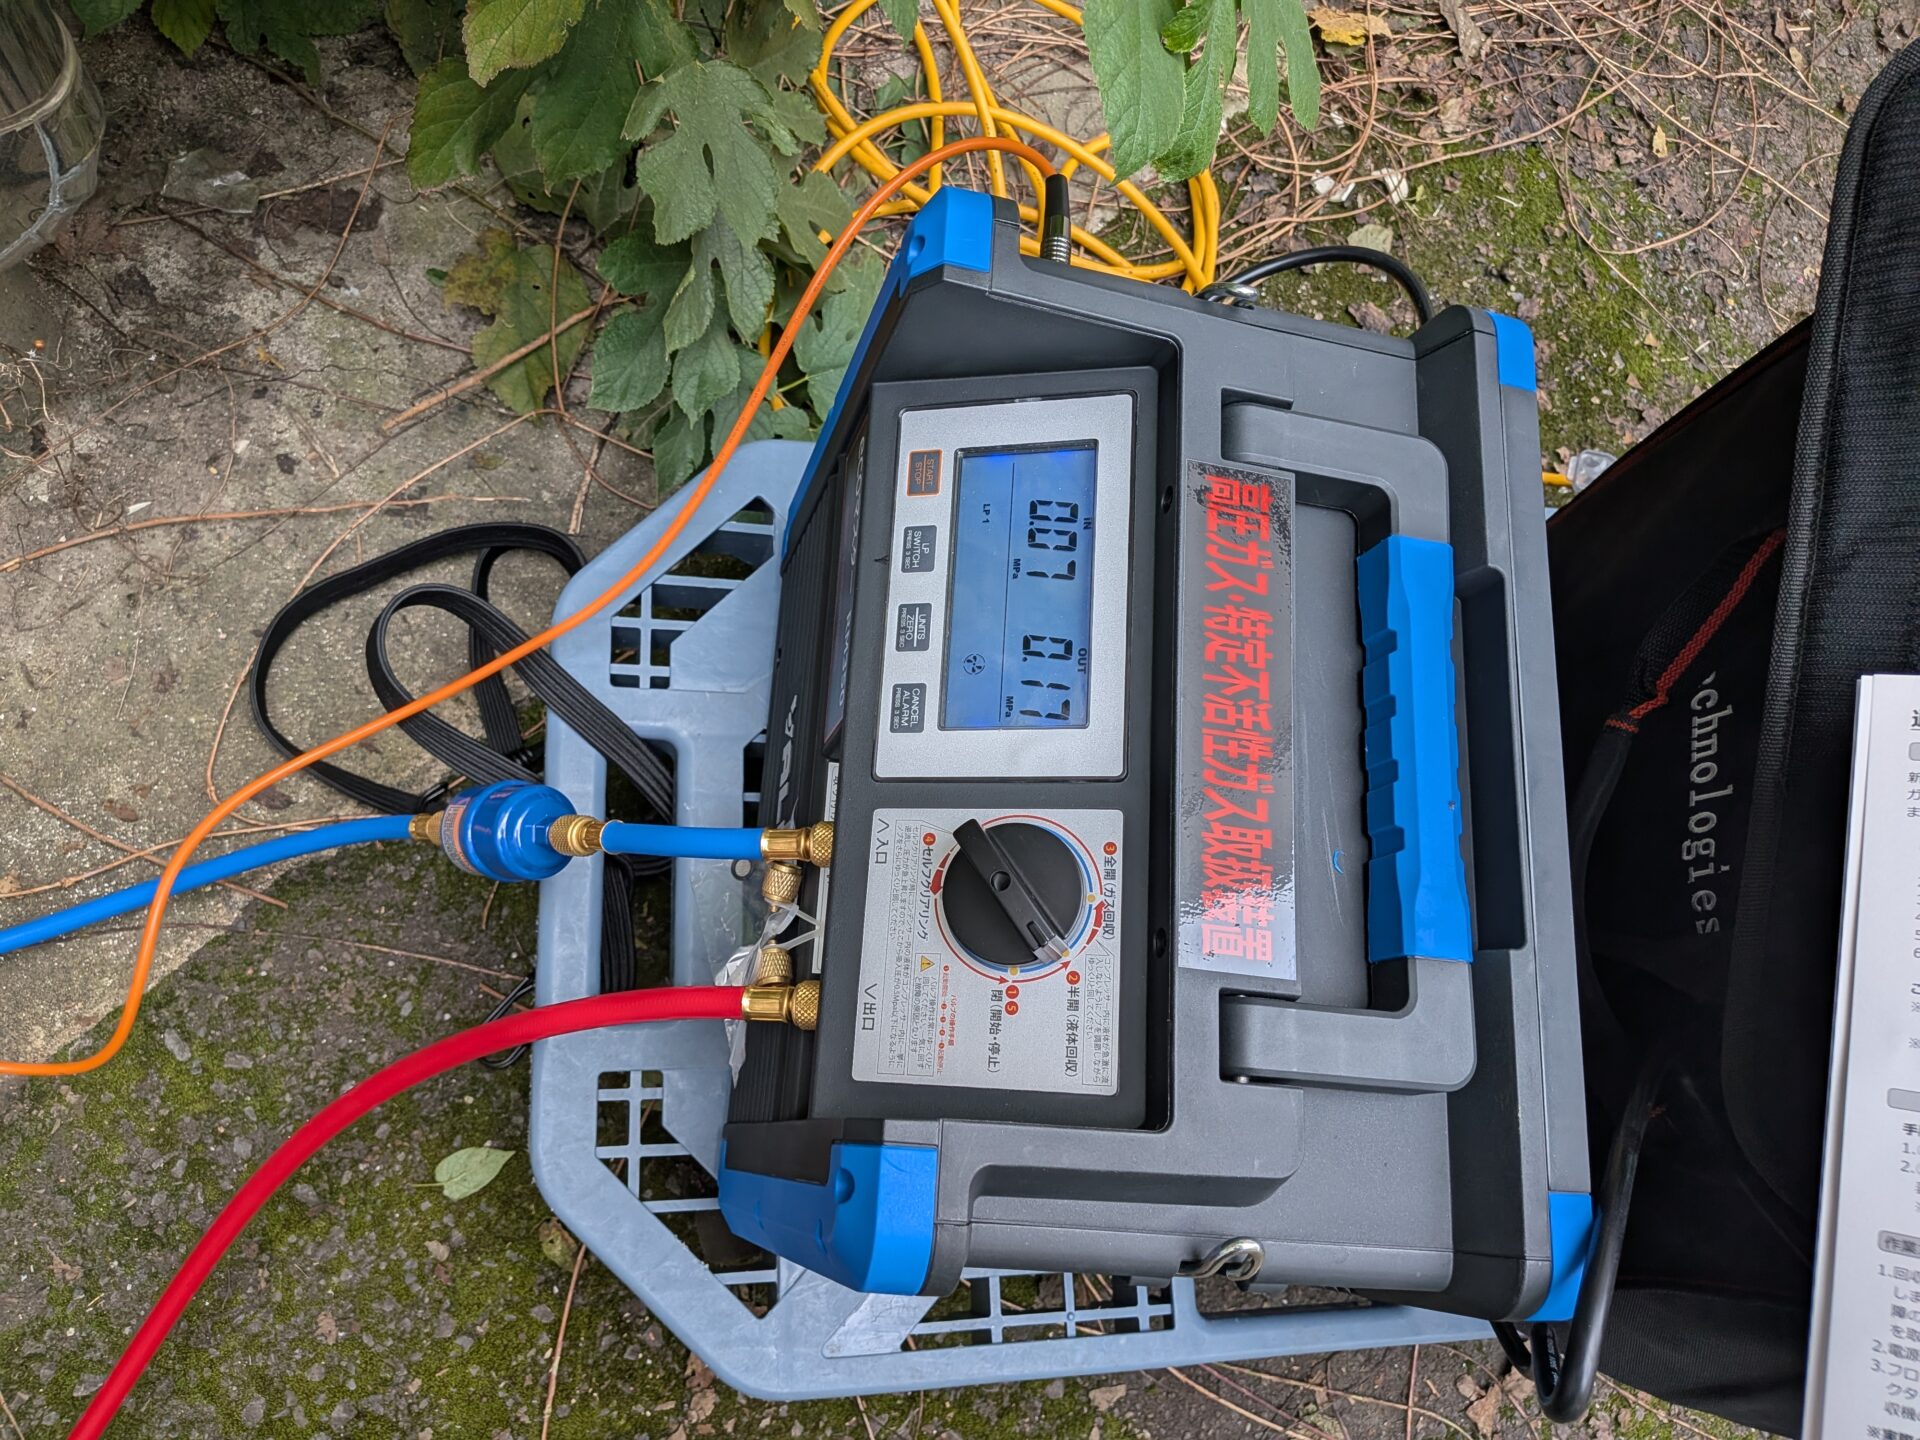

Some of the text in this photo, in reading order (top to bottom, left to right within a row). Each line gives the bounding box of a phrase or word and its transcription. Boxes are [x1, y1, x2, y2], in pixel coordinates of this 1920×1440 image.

[914, 461, 923, 484] STOP
[926, 458, 934, 485] START
[982, 503, 991, 516] LP
[1083, 517, 1092, 530] IN
[912, 531, 921, 568] SWITCH
[921, 542, 930, 554] LP
[1026, 500, 1079, 581] 0.07
[1012, 558, 1021, 579] MPa
[899, 608, 907, 627] PRESS
[905, 615, 914, 640] ZERO
[917, 614, 927, 640] UNITS
[1077, 648, 1087, 675] OUT
[1019, 635, 1073, 721] 0.17
[894, 687, 902, 707] PRESS
[900, 690, 911, 726] ALARM
[909, 688, 920, 727] CANCEL
[1004, 696, 1014, 718] MPa
[1200, 475, 1275, 963] 高圧ガス・特定不活性ガス取扱装置
[1681, 671, 1734, 934] chnologies
[875, 838, 889, 865] 入口
[917, 847, 931, 941] セルフクリアリング
[1102, 856, 1116, 940] 全開（ガス回収）
[862, 1002, 876, 1031] 出口
[987, 990, 1003, 1073] 閉（開始・停止）
[1065, 986, 1079, 1077] 半開（液体回収）
